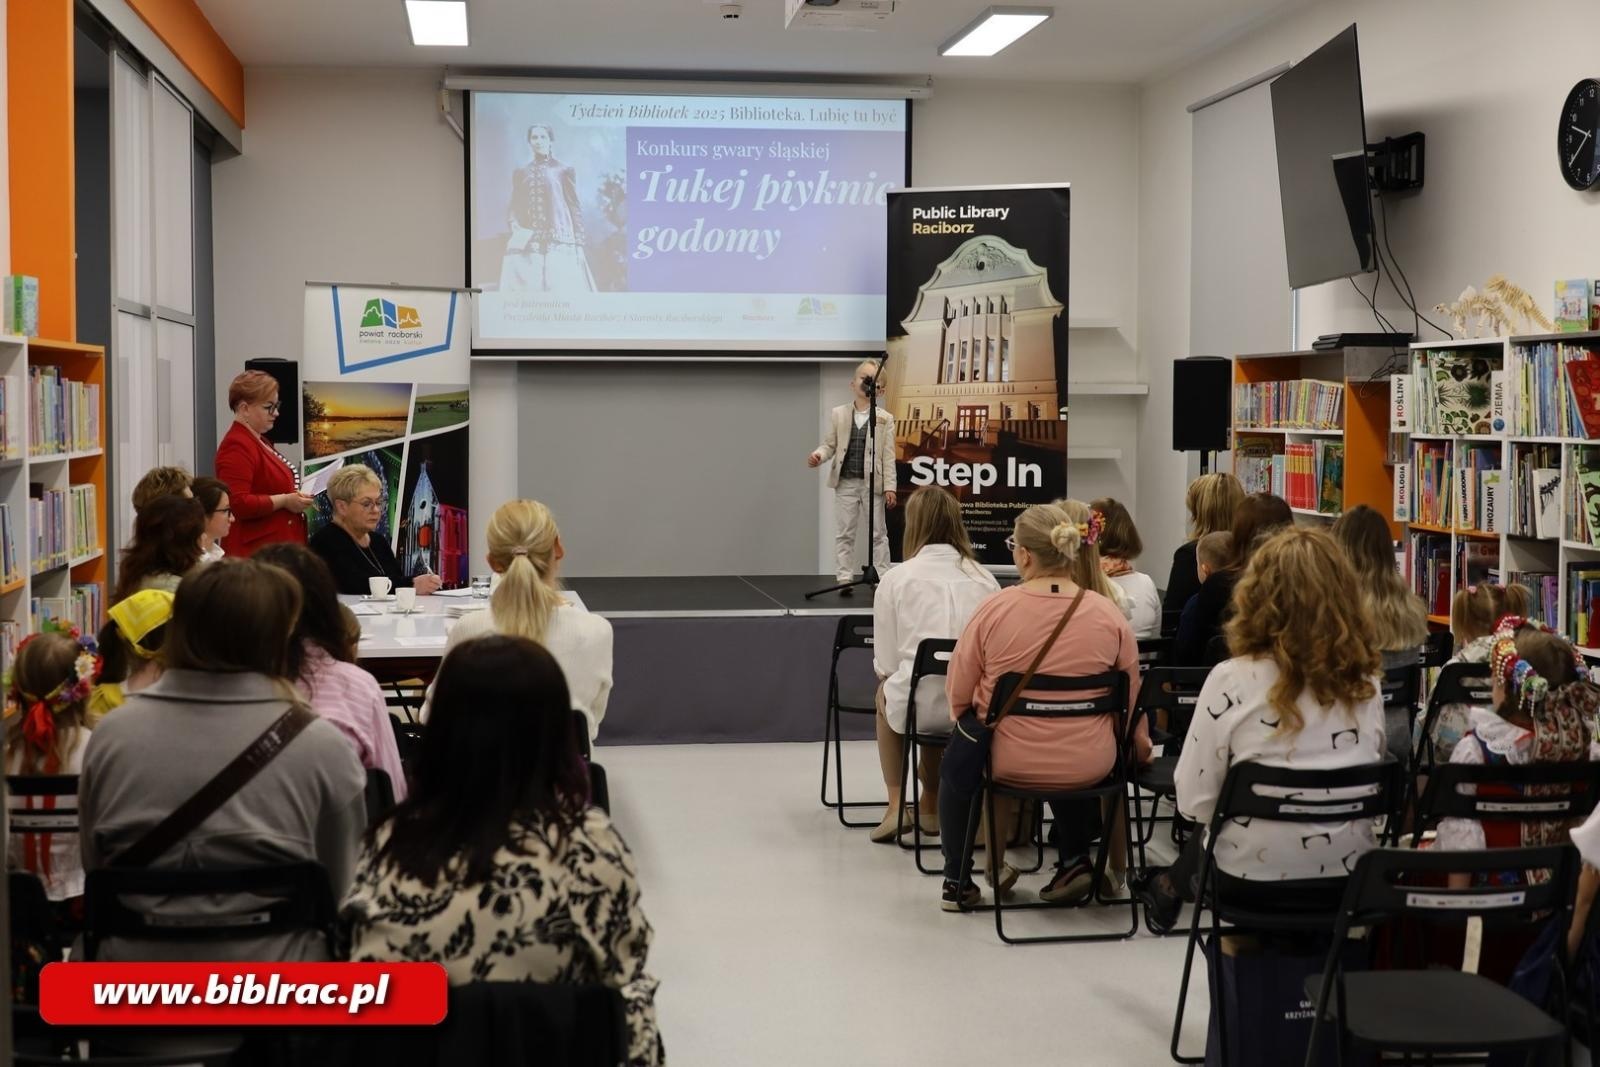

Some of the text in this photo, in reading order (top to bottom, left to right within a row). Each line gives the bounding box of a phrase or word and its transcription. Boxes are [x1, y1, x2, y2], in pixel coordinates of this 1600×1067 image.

[569, 103, 897, 126] Tydzień Bibliotek 2025 Biblioteka. Lubię tu być
[637, 140, 831, 162] Konkurs gwary śląskiej
[639, 164, 895, 212] Tukej piyknie
[912, 205, 1010, 220] Public Library
[912, 221, 975, 235] Raciborz
[632, 217, 782, 261] godomy
[1396, 376, 1405, 418] ROŚLINY
[1494, 382, 1504, 416] ZIEMIA
[910, 455, 1042, 494] Step In
[975, 501, 1008, 509] Biblioteka
[1486, 485, 1495, 533] DINOZAURY
